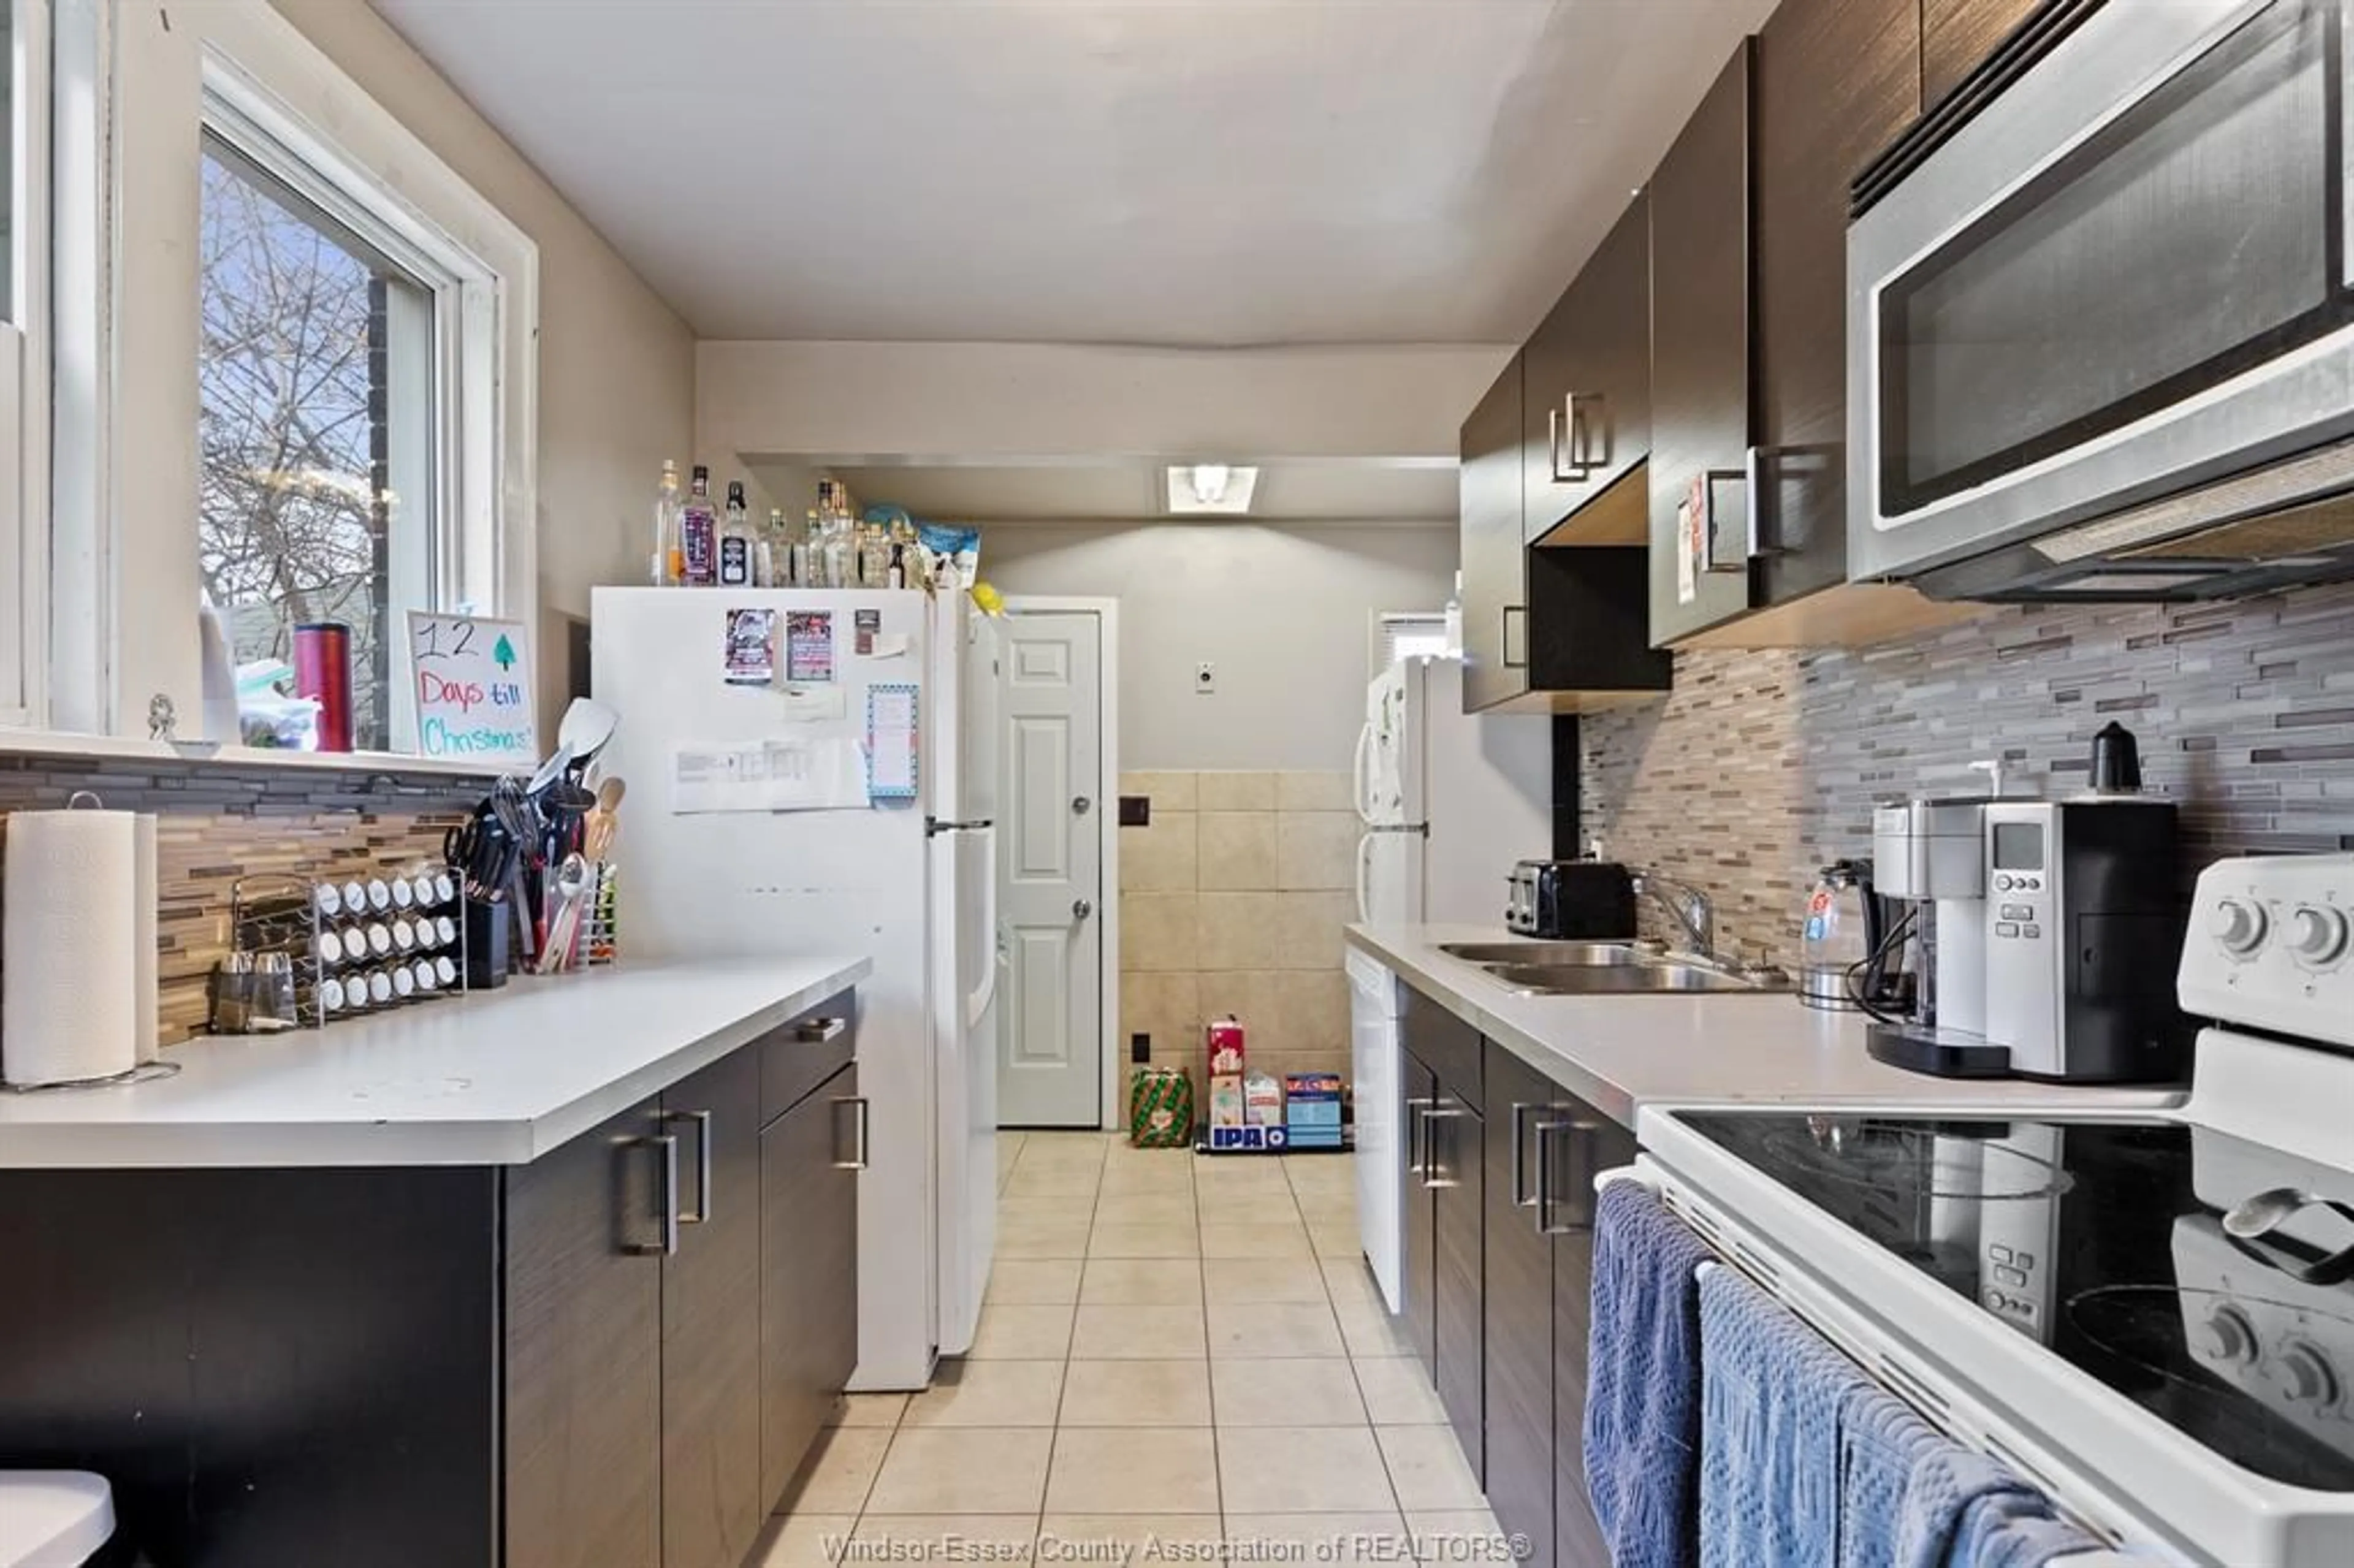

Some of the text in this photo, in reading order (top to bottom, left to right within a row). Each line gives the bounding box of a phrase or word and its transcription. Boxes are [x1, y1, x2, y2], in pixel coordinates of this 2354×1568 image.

[417, 622, 479, 660] 12
[421, 670, 520, 714] Days till
[1214, 1128, 1263, 1147] IPA
